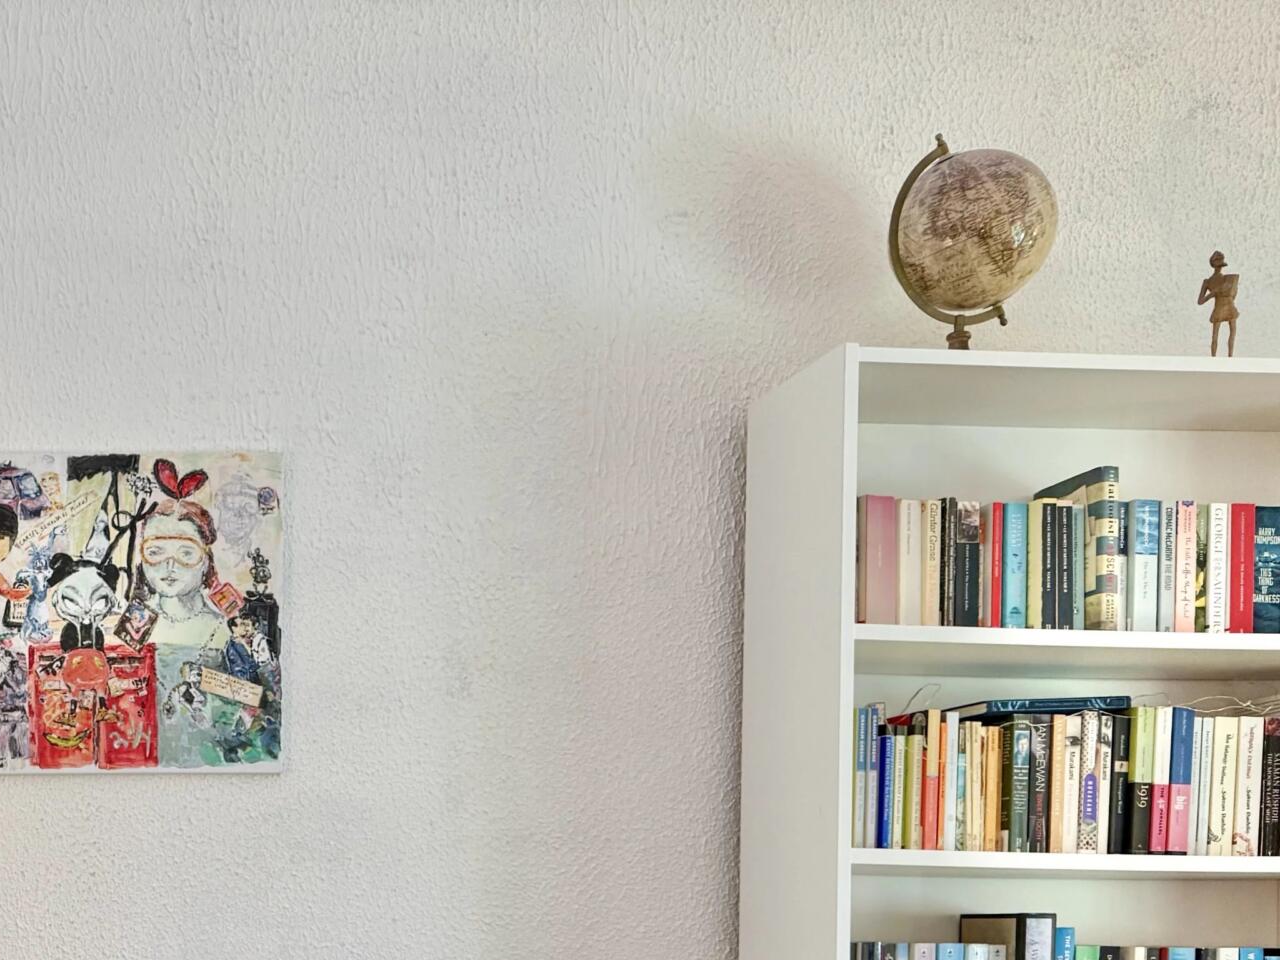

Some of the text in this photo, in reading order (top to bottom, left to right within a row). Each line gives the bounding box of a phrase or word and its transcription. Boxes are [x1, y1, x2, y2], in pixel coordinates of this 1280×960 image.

[1165, 508, 1173, 531] CORMAC
[1214, 508, 1223, 554] GEORGE
[1165, 533, 1173, 561] McCARTHY
[1035, 744, 1045, 791] McEWAN
[1068, 751, 1076, 780] Murakami
[1085, 781, 1093, 815] MURAKAMI
[1137, 785, 1149, 807] 1919
[1272, 753, 1280, 823] SALMAN RUSHDIE
[1175, 796, 1187, 810] big
